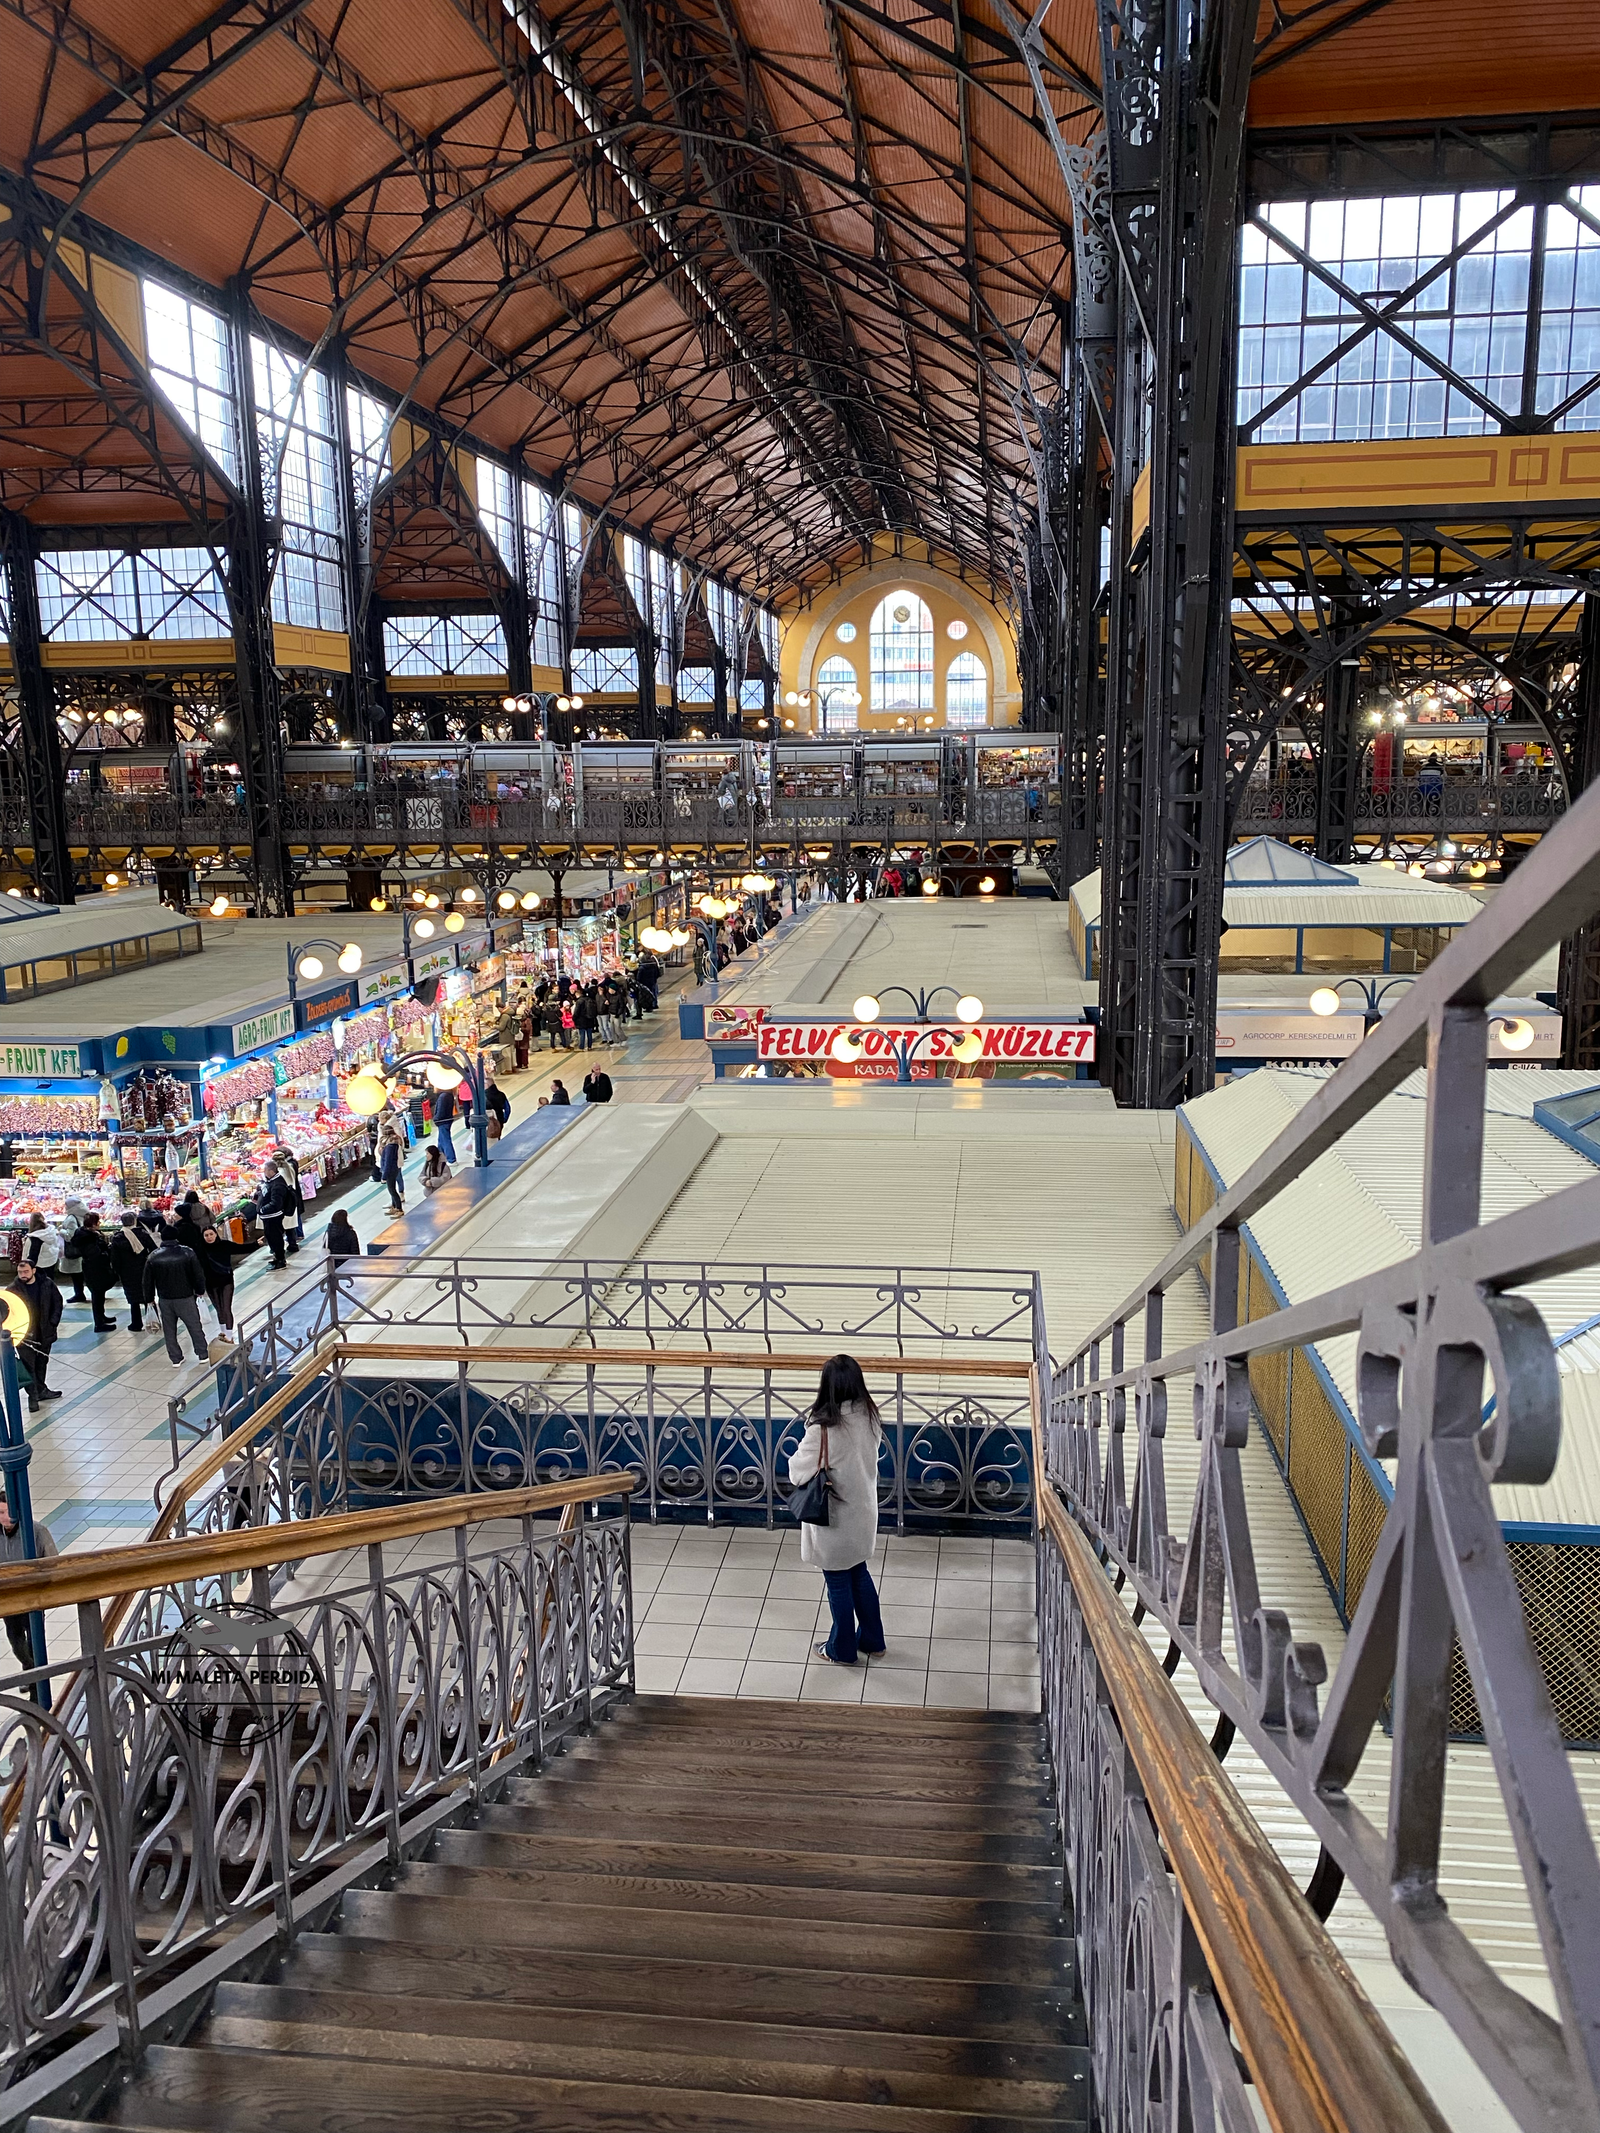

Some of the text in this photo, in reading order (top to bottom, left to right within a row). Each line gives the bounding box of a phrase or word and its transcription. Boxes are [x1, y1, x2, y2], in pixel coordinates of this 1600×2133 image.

[238, 1012, 278, 1051] AGRO-FRUIT
[1243, 1032, 1285, 1040] AGROCORP
[1289, 1032, 1345, 1040] KERESKEDELMI
[51, 1049, 80, 1075] KFT.
[854, 1064, 930, 1077] KABAOS
